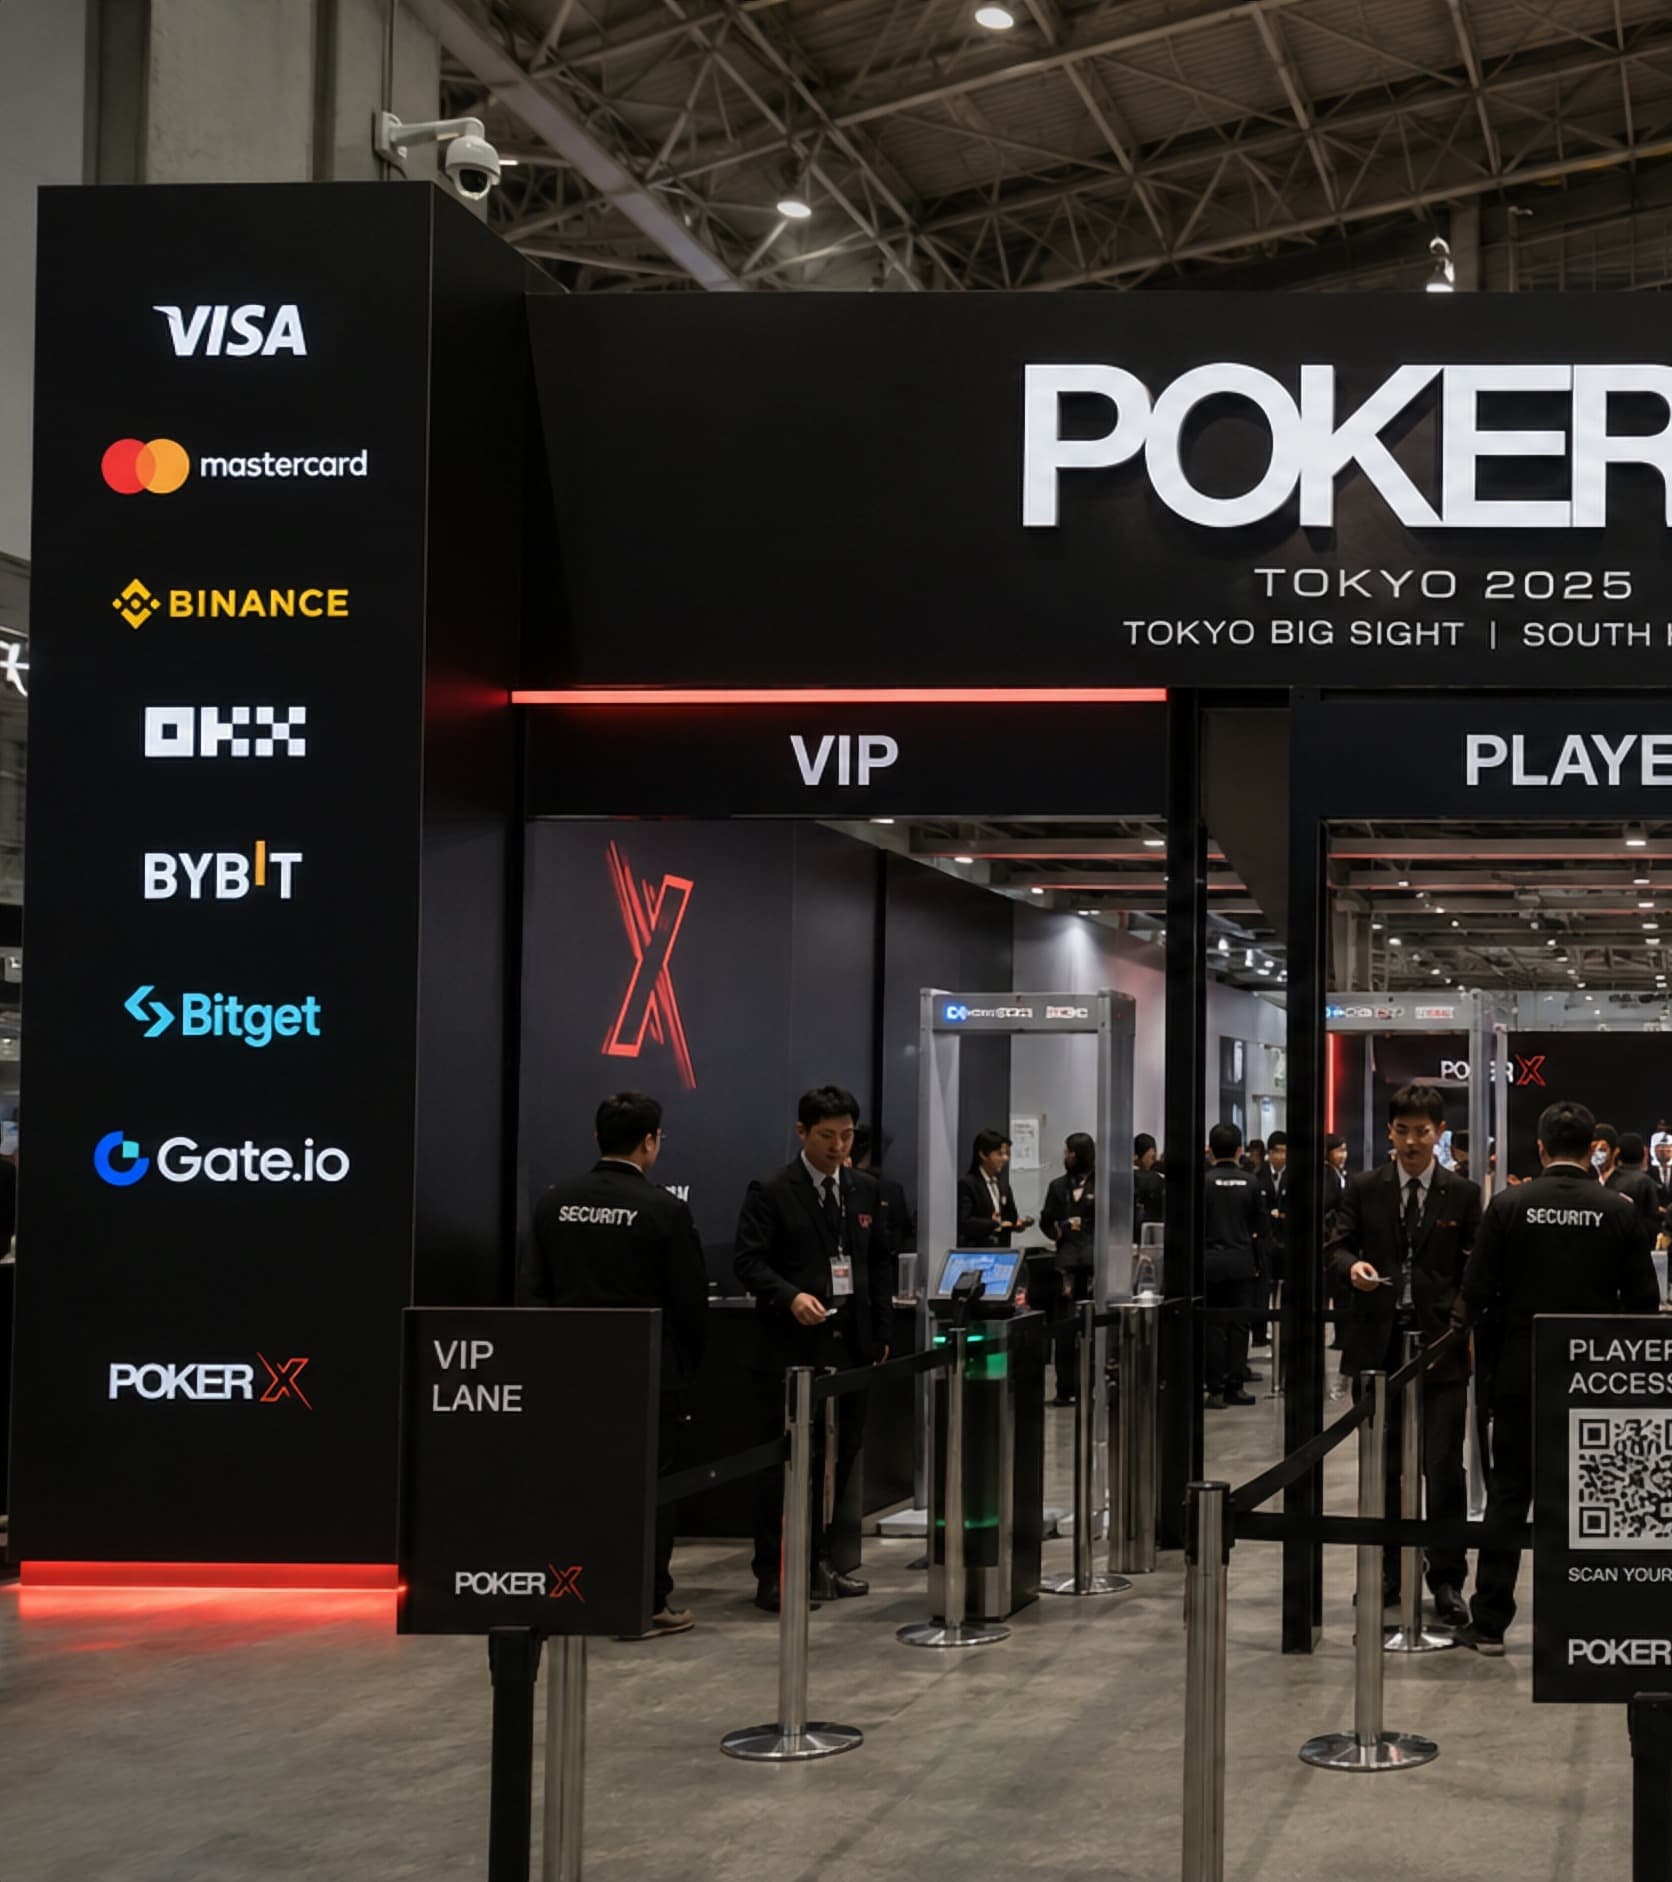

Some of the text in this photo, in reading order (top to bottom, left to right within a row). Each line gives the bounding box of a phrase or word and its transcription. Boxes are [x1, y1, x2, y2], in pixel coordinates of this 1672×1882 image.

[152, 304, 308, 357] VISA
[200, 449, 368, 478] mastercard
[1253, 568, 1632, 600] TOKYO 2025
[169, 588, 349, 618] BINANCE
[1123, 619, 1255, 646] TOKYO
[1271, 619, 1334, 645] BIG
[1350, 620, 1465, 646] SIGHT
[1523, 622, 1651, 647] SOUTH
[144, 706, 307, 758] OKX
[789, 734, 899, 786] VIP
[144, 840, 303, 900] BYBIT
[182, 992, 321, 1048] Bitget
[156, 1136, 350, 1183] Gate.io
[558, 1205, 638, 1227] SECURITY
[1526, 1207, 1604, 1227] SECURITY
[433, 1339, 494, 1370] VIP
[108, 1362, 254, 1400] POKER
[432, 1383, 523, 1412] LANE
[455, 1571, 546, 1595] POKER
[1568, 1566, 1619, 1582] SCAN
[1623, 1567, 1672, 1583] YOUR
[1567, 1638, 1672, 1666] POKER
